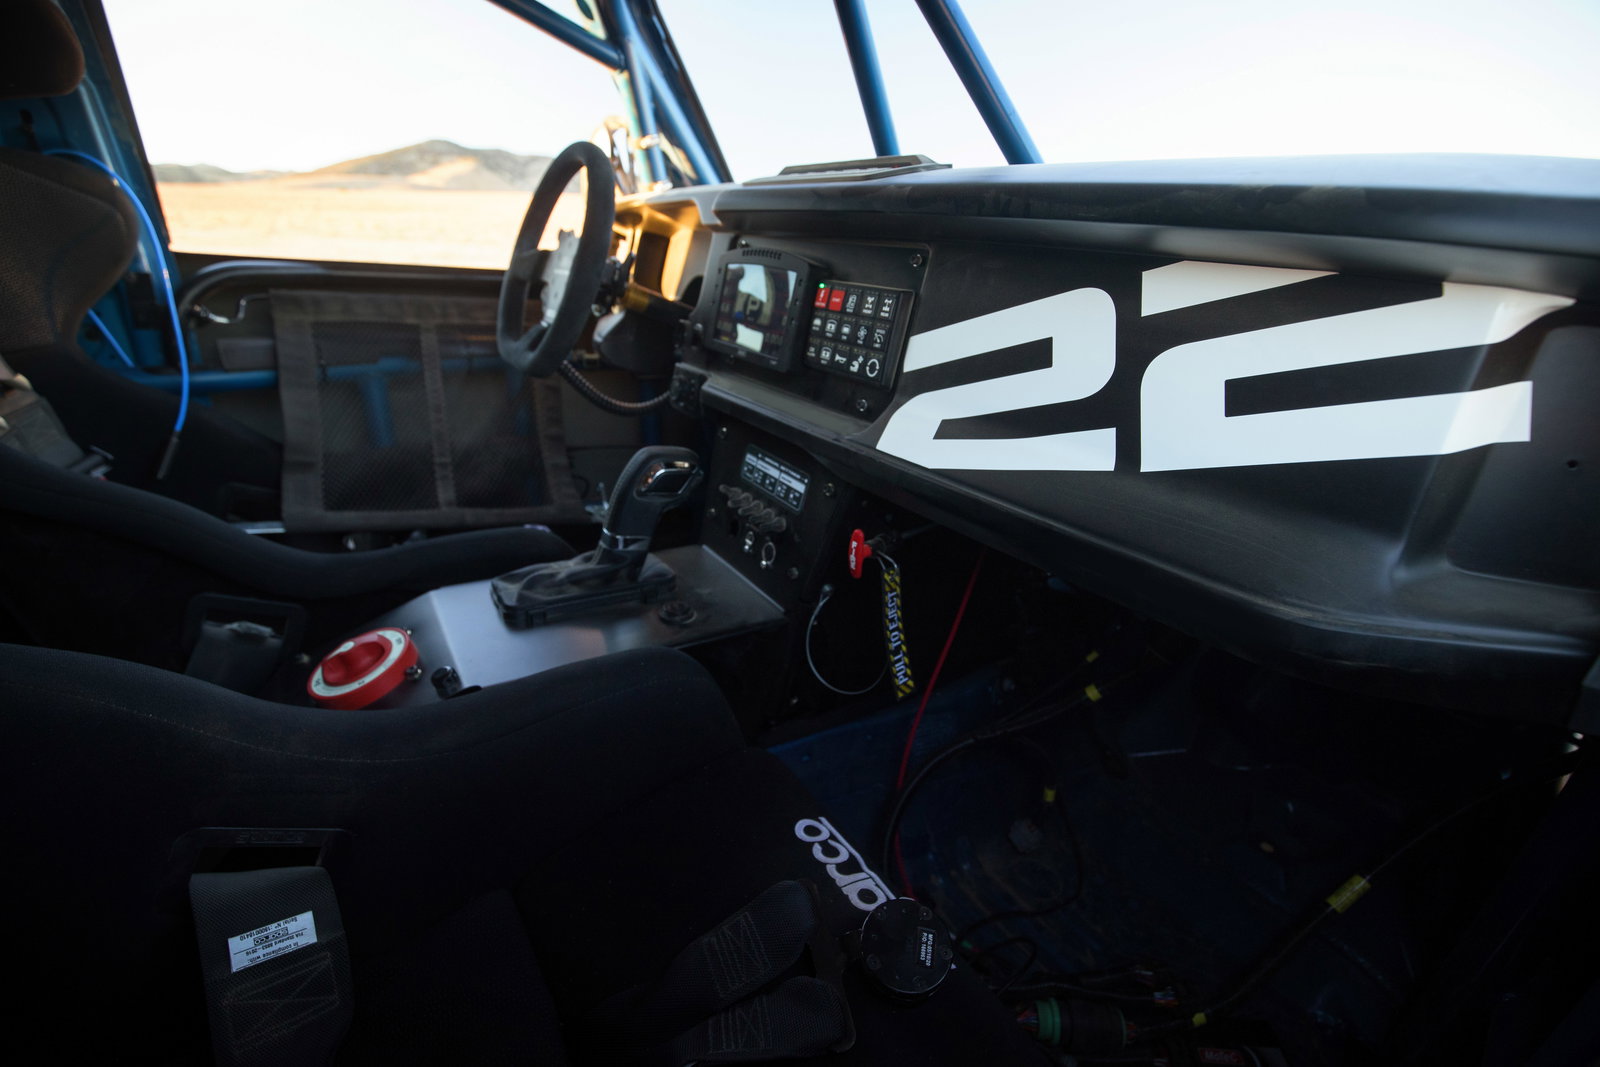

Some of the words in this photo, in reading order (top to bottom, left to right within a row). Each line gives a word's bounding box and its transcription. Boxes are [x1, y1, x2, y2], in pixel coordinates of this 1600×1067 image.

[876, 260, 1576, 473] 22
[887, 591, 899, 631] EJECT
[890, 631, 902, 650] TO
[894, 650, 909, 685] PULL
[795, 816, 897, 912] arco
[282, 916, 298, 926] Serial
[262, 944, 292, 957] compliance
[274, 934, 295, 945] Standard
